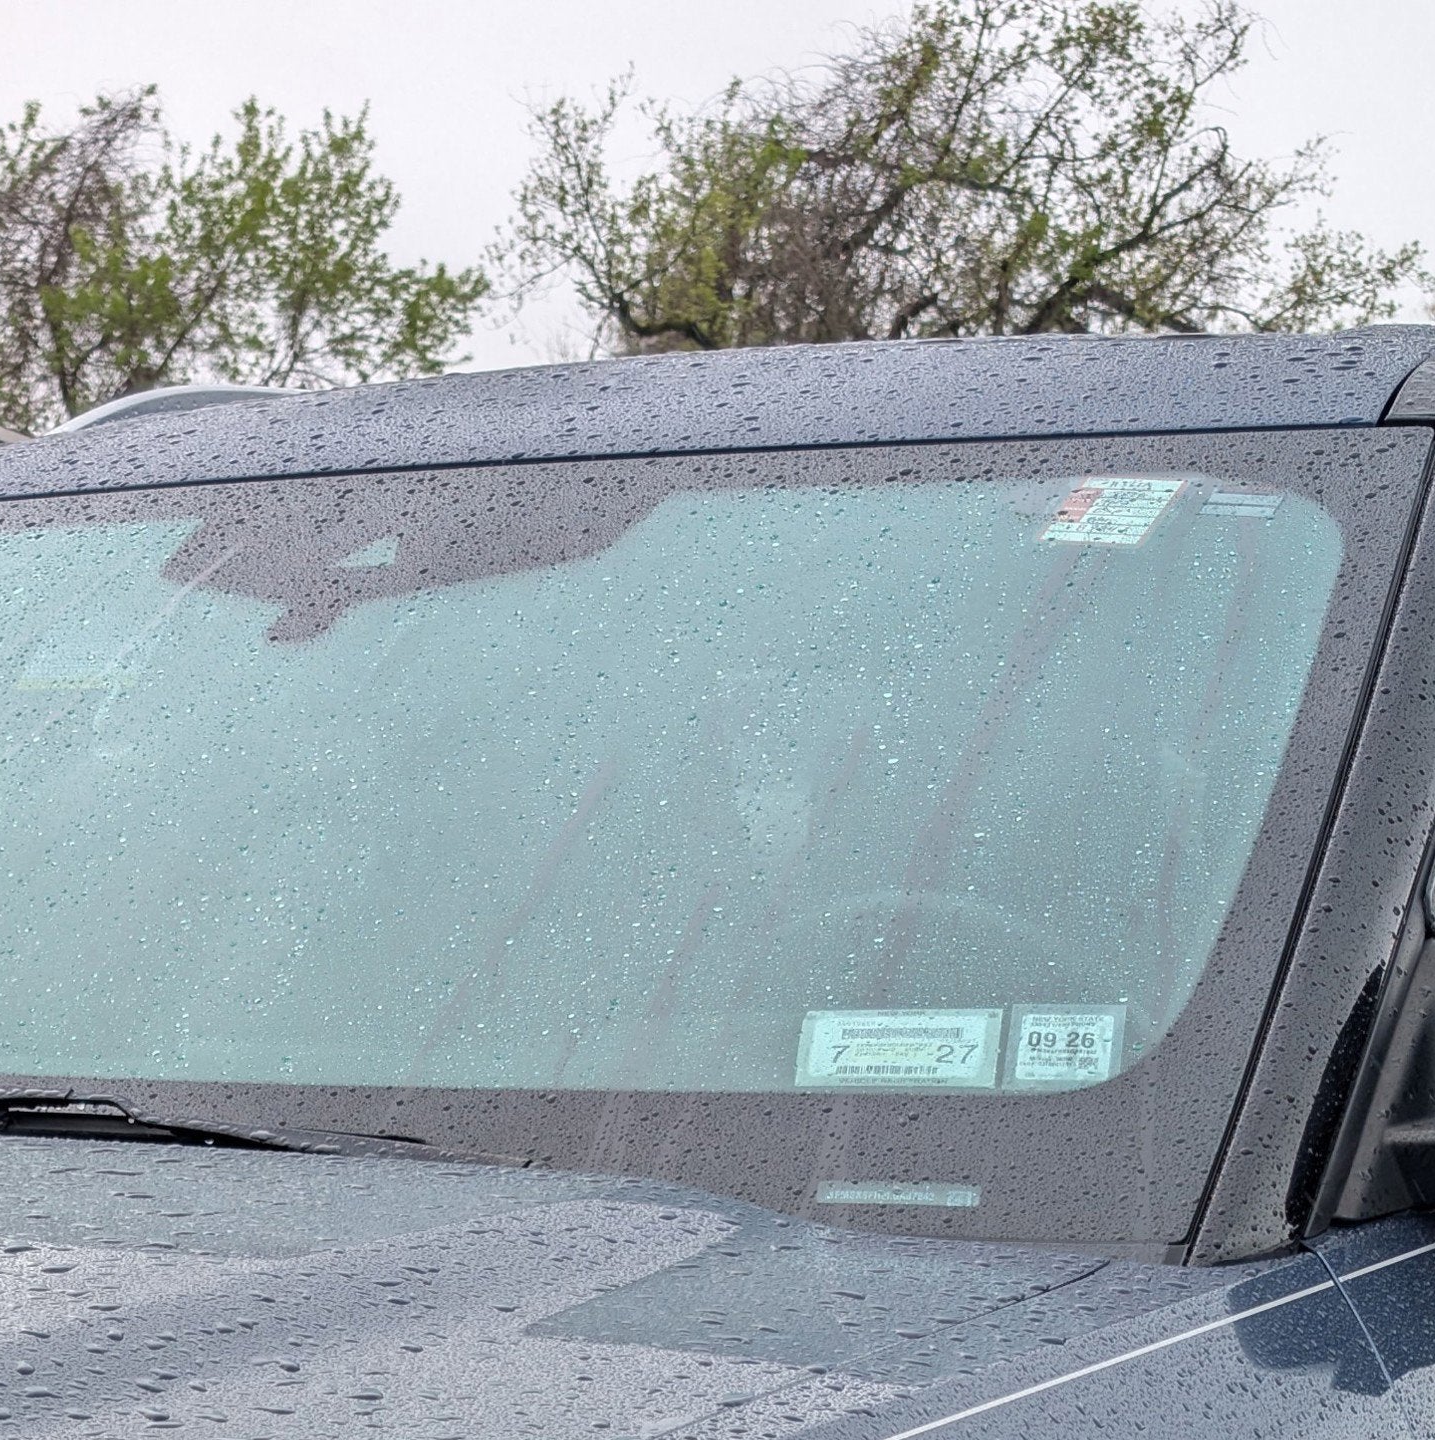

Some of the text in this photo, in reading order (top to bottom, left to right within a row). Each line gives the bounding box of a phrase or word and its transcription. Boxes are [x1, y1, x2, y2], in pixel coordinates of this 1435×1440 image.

[1027, 1030, 1095, 1048] 09 26
[830, 1044, 851, 1064] 7
[935, 1043, 979, 1064] 27
